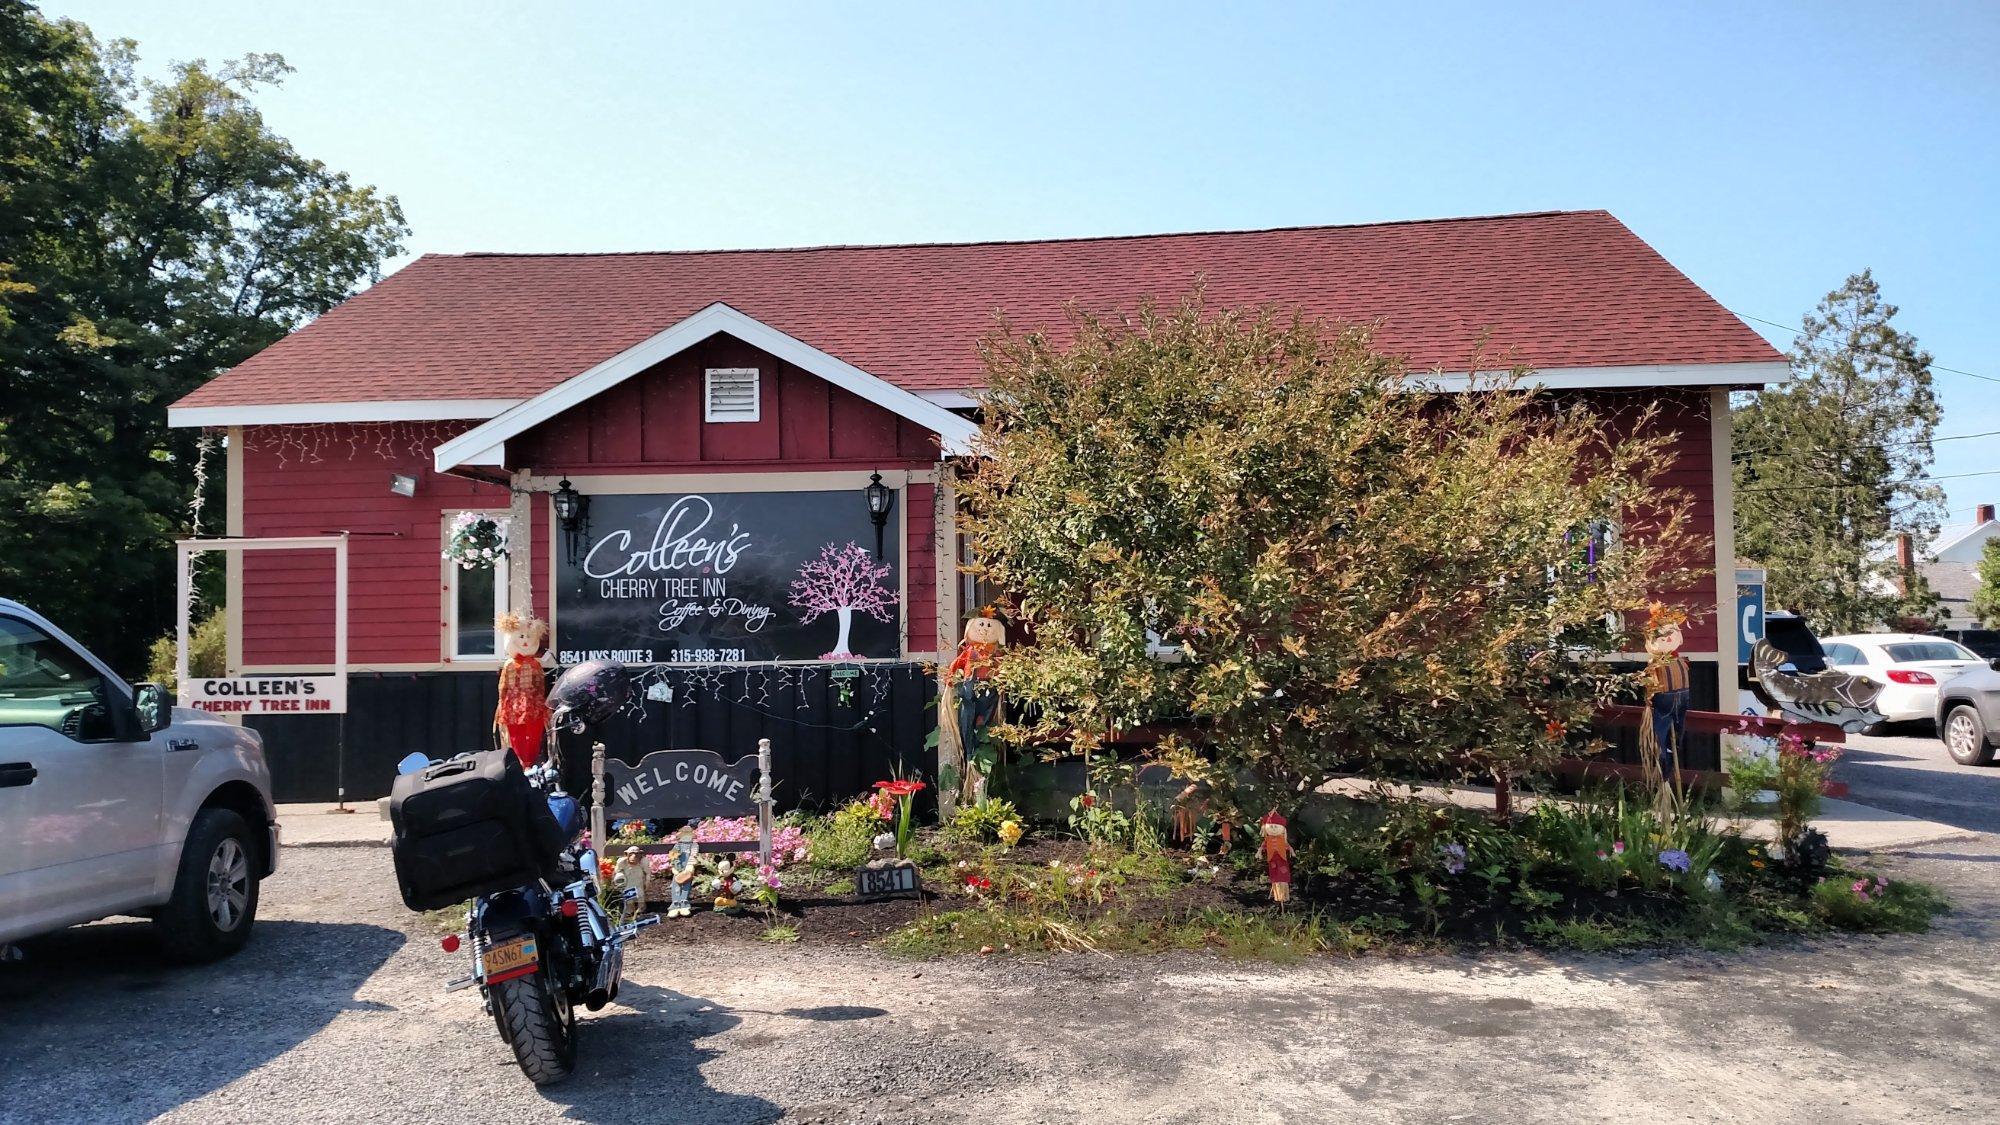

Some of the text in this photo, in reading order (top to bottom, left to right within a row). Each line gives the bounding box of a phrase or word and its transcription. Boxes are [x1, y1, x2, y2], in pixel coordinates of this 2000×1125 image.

[583, 494, 752, 579] Colleen's
[600, 577, 726, 599] CHERRY TREE INN
[658, 598, 776, 633] Coffee & Dining
[559, 651, 586, 663] 8541
[612, 650, 643, 663] ROUTE
[646, 650, 653, 663] 3
[670, 649, 746, 662] 315-938-7281
[192, 699, 331, 713] CHERRY TREE INN
[616, 761, 745, 806] WELCOME
[867, 868, 903, 892] 8541
